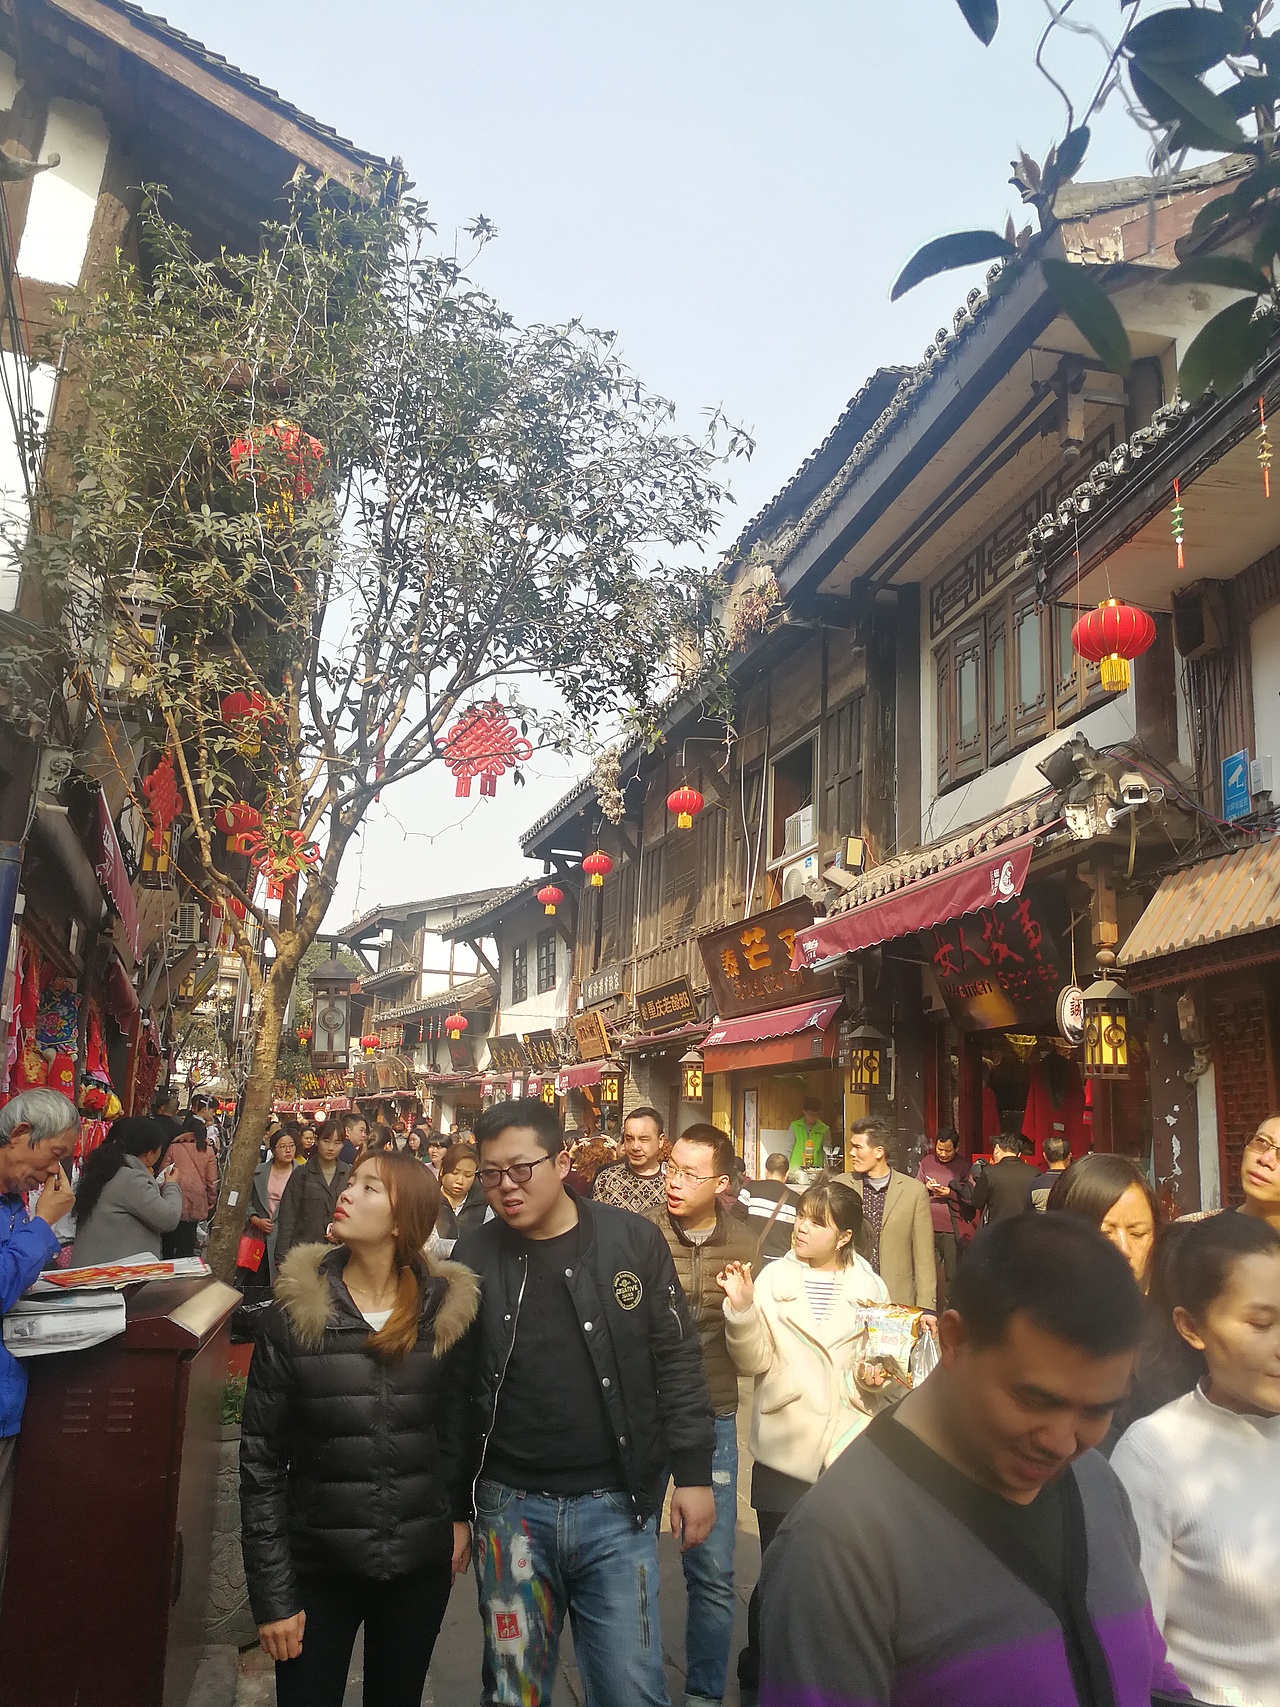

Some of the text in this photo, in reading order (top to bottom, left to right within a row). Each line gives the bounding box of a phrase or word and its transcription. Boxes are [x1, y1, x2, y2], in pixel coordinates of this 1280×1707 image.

[933, 897, 1042, 977] 女人故事
[945, 980, 993, 998] Women
[647, 991, 690, 1020] 重庆老酸奶
